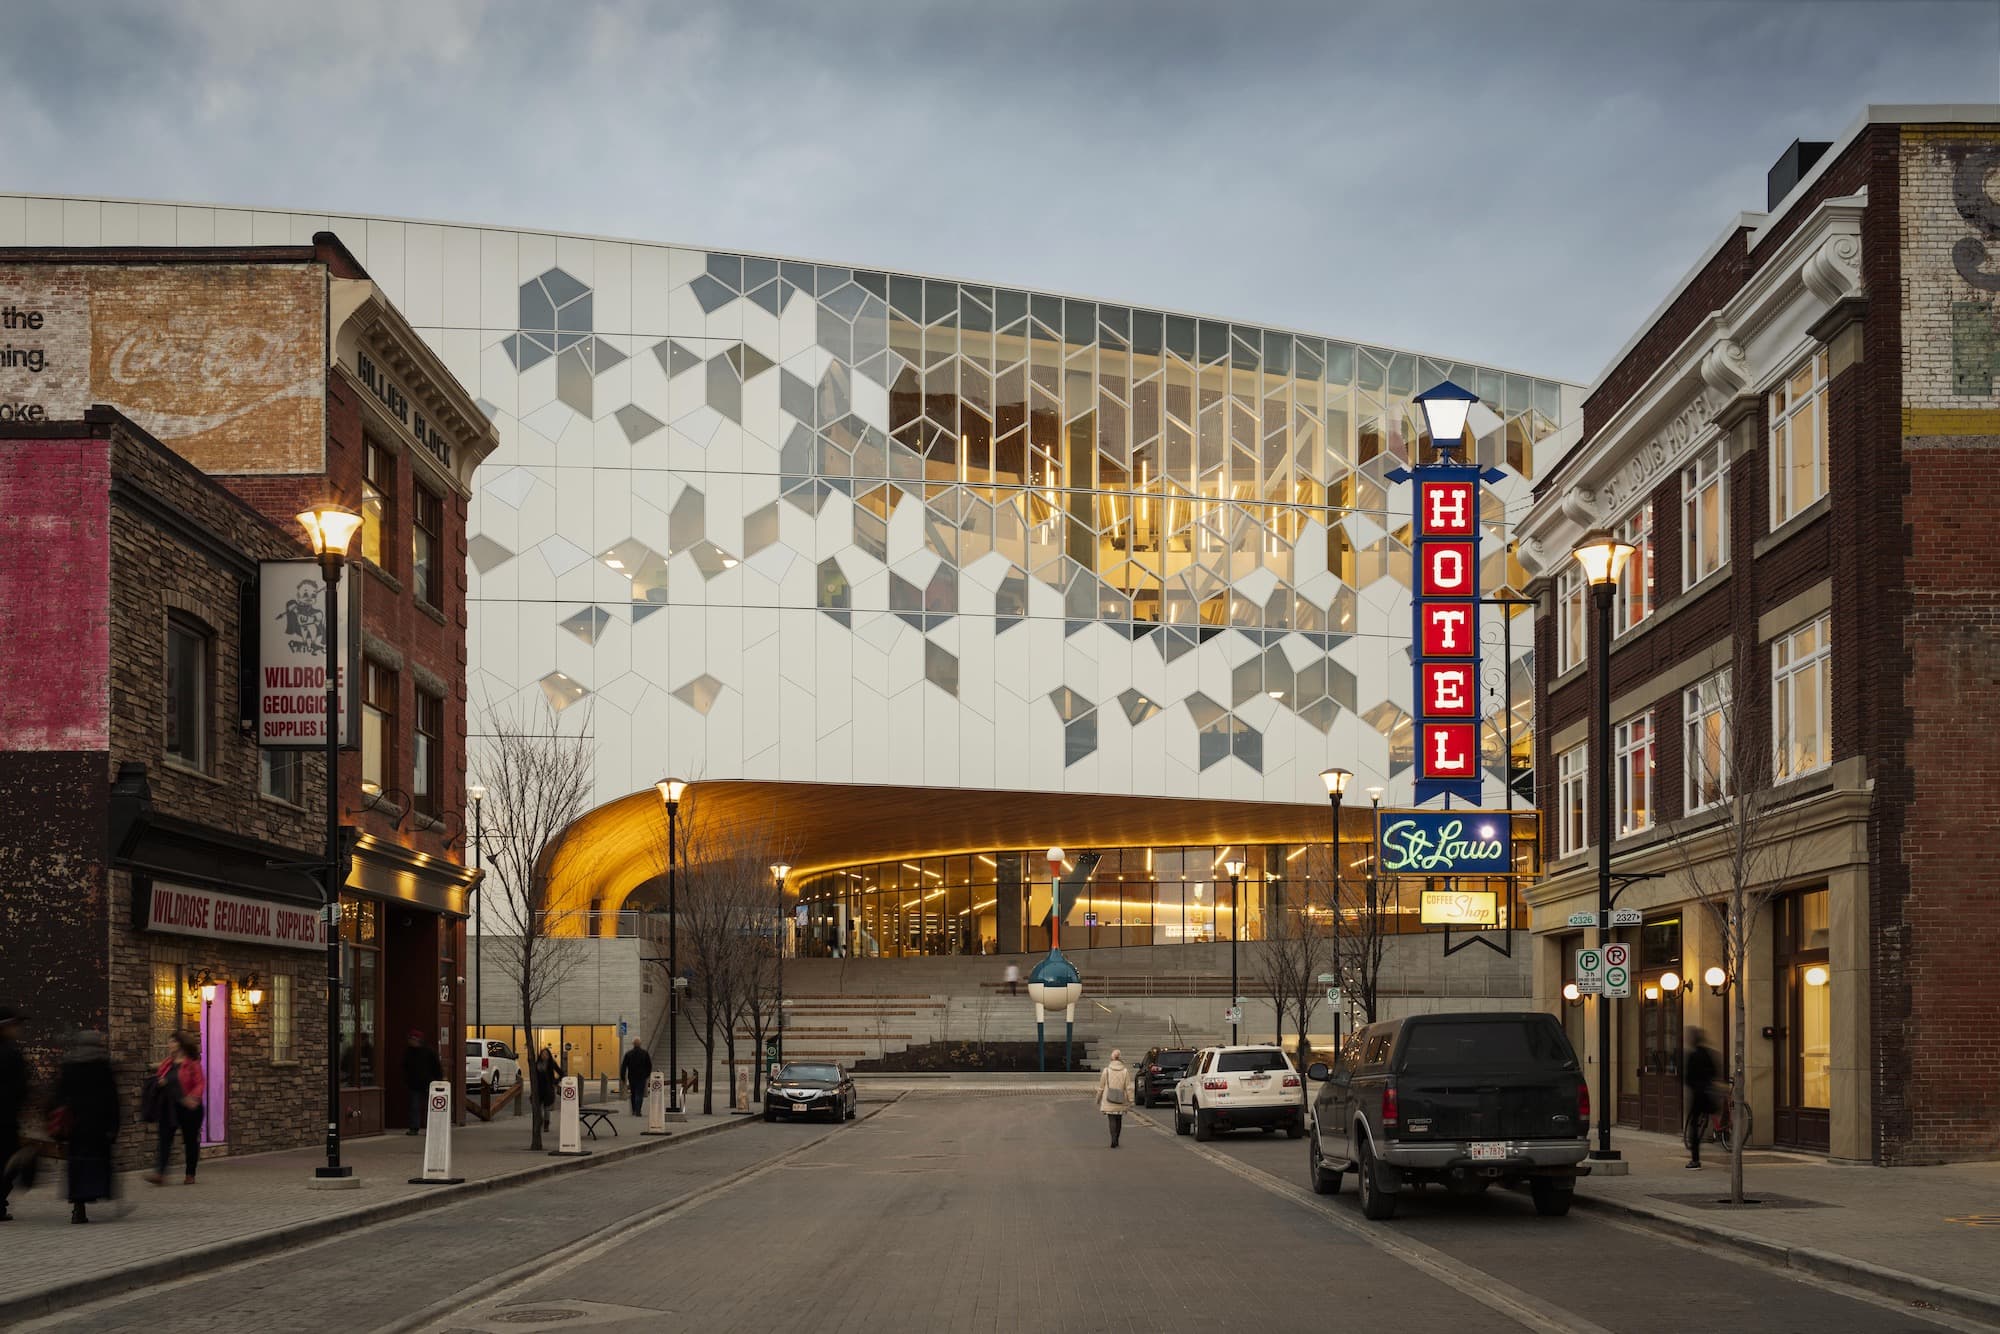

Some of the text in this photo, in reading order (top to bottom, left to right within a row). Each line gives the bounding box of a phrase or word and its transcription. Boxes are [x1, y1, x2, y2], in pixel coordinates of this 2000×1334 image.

[2, 306, 44, 330] the
[358, 351, 451, 469] HILLIER BLOCK
[1623, 440, 1667, 492] LOUIS
[1664, 391, 1722, 455] HOTEL
[1430, 489, 1466, 769] HOTEL
[264, 666, 344, 688] WILDROE
[263, 695, 345, 714] GEOLOGICL
[264, 720, 317, 737] SUPPLIES
[1382, 820, 1502, 870] St. Louis
[1426, 895, 1453, 905] COFFEE
[1446, 895, 1489, 921] Shop
[154, 889, 209, 929] WILDROSE
[214, 901, 271, 937] GEOLOGICAL
[276, 909, 315, 944] SUPPLIES
[1616, 913, 1636, 922] 2327
